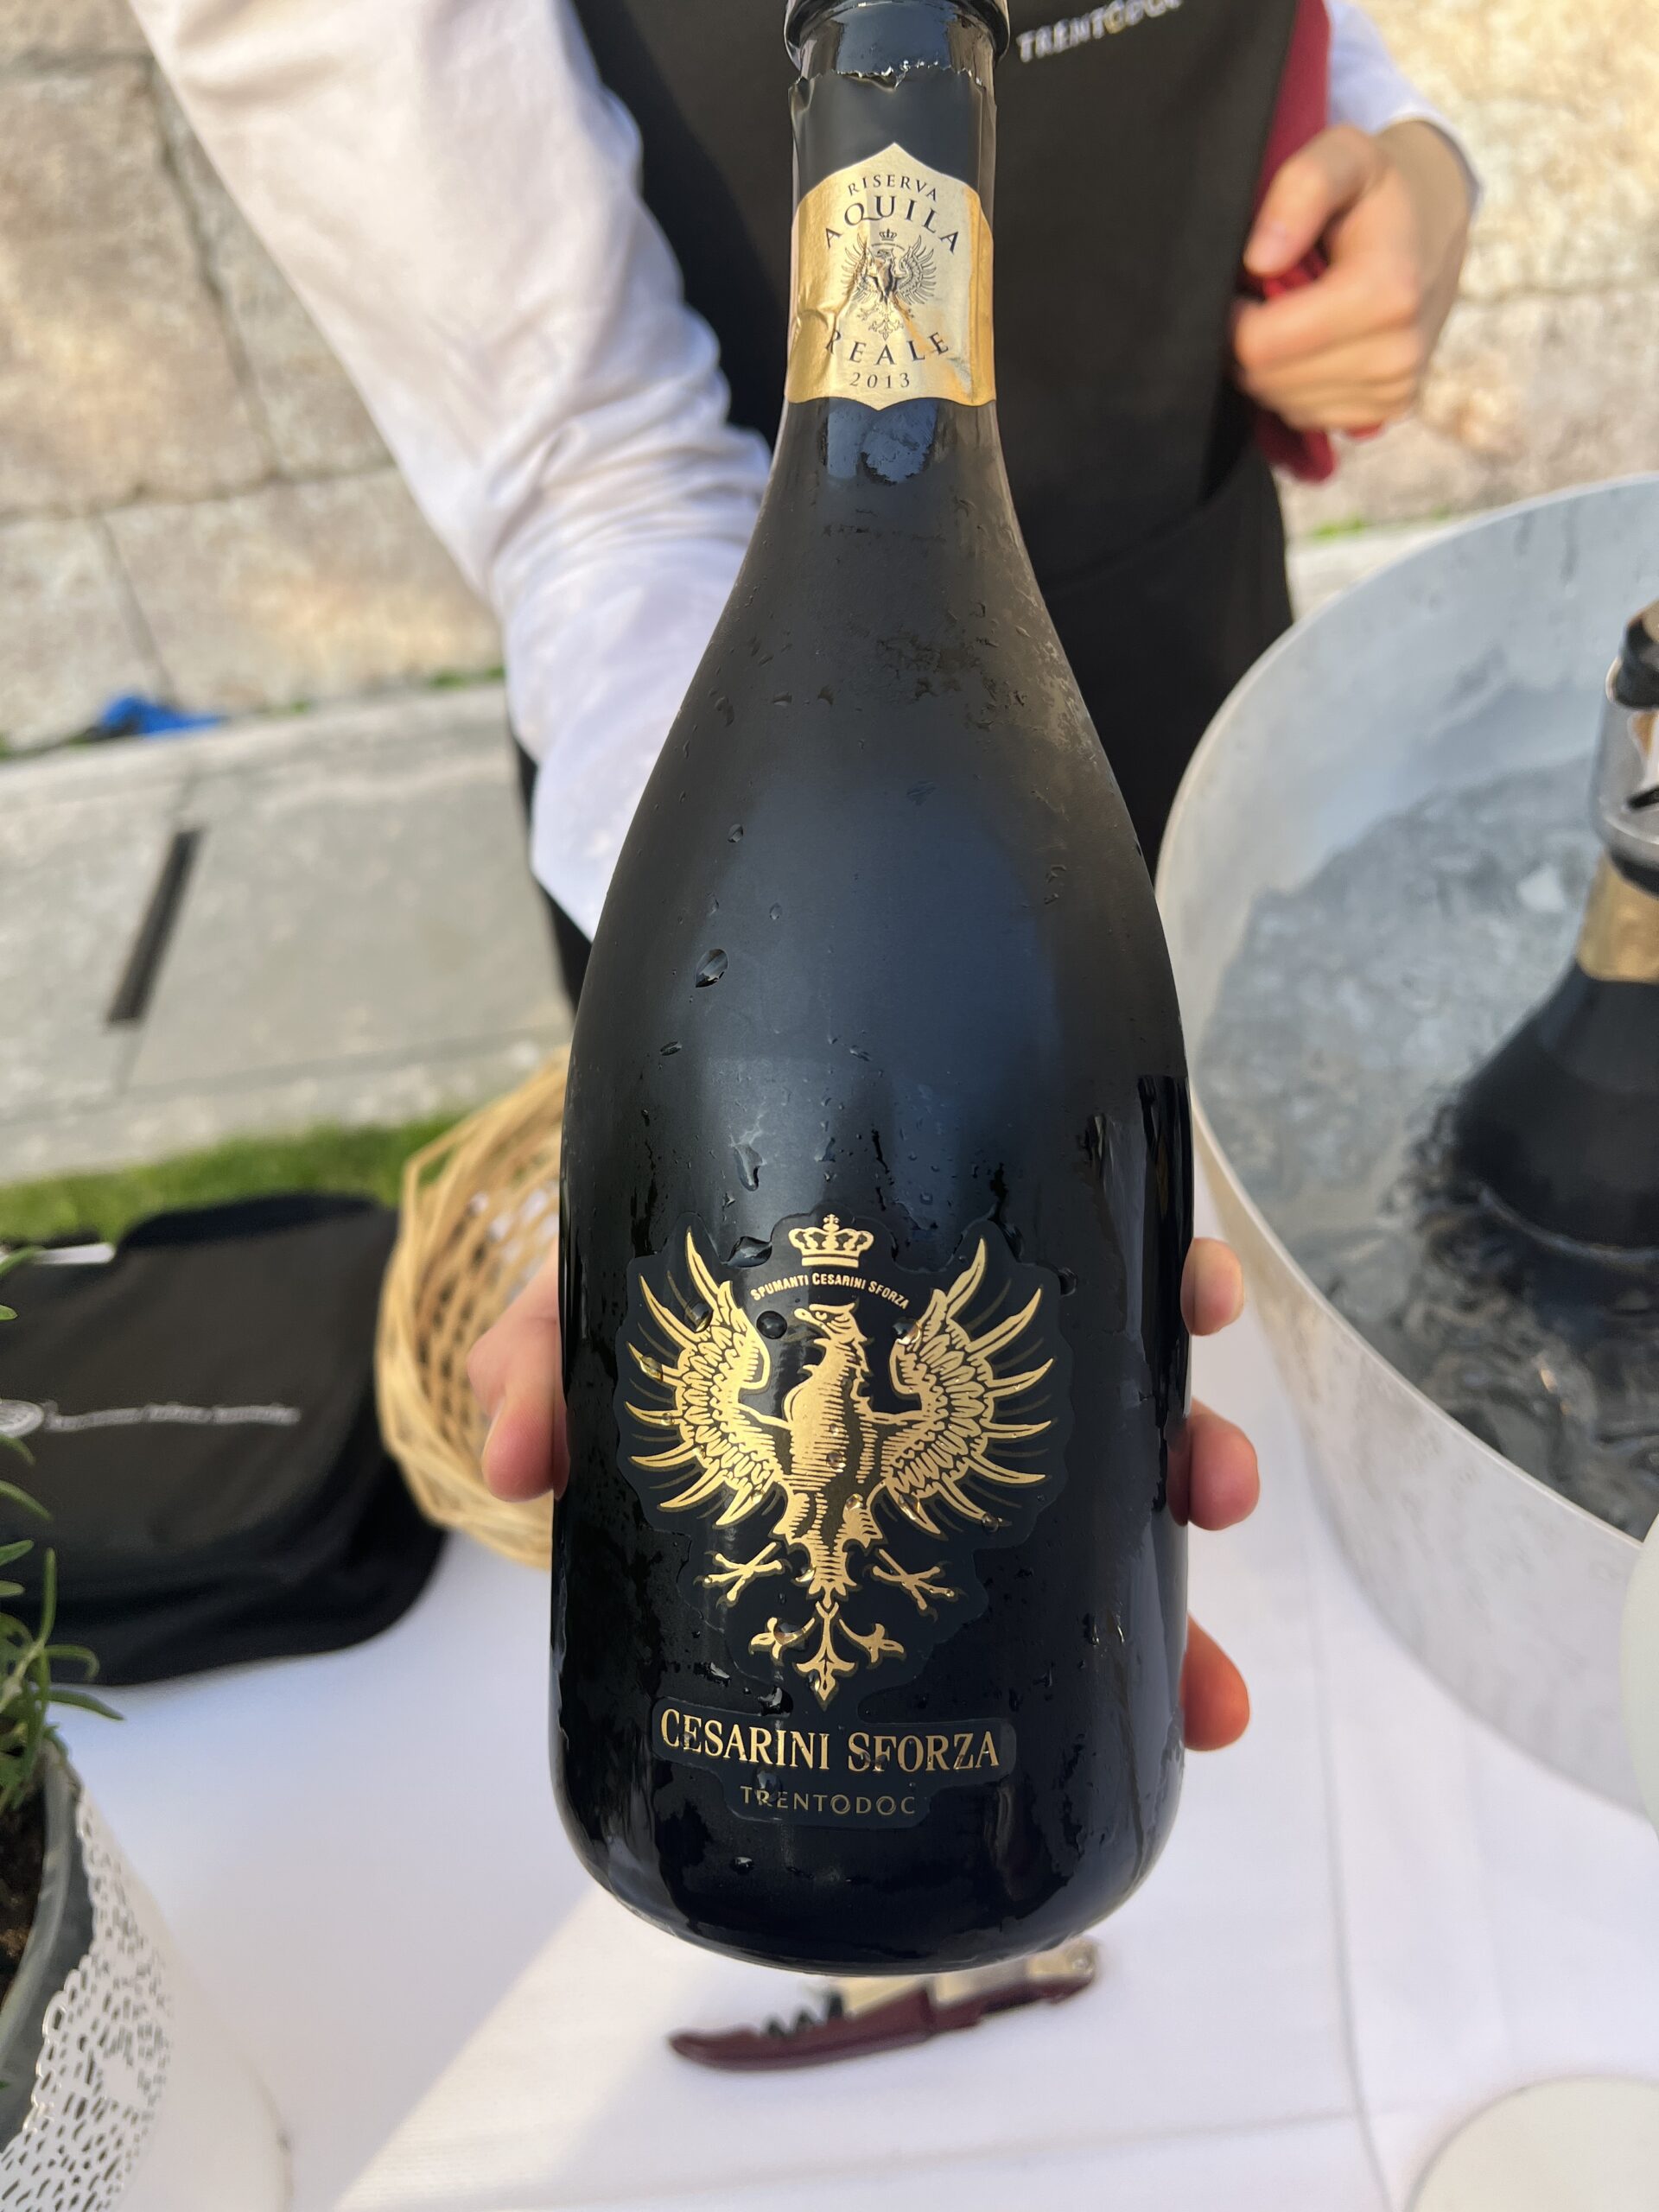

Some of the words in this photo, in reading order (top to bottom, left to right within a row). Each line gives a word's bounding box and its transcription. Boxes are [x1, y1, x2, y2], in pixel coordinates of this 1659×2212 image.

[848, 174, 938, 202] RISERVA
[825, 195, 959, 254] AQUILA
[849, 372, 911, 389] 2013
[749, 1274, 810, 1301] SPUMANTI
[811, 1272, 867, 1290] CESARINI
[868, 1281, 910, 1310] SFORZA
[660, 1707, 830, 1770] CESARINI
[847, 1731, 1000, 1773] SFORZA
[740, 1785, 916, 1815] TRENTODOC
